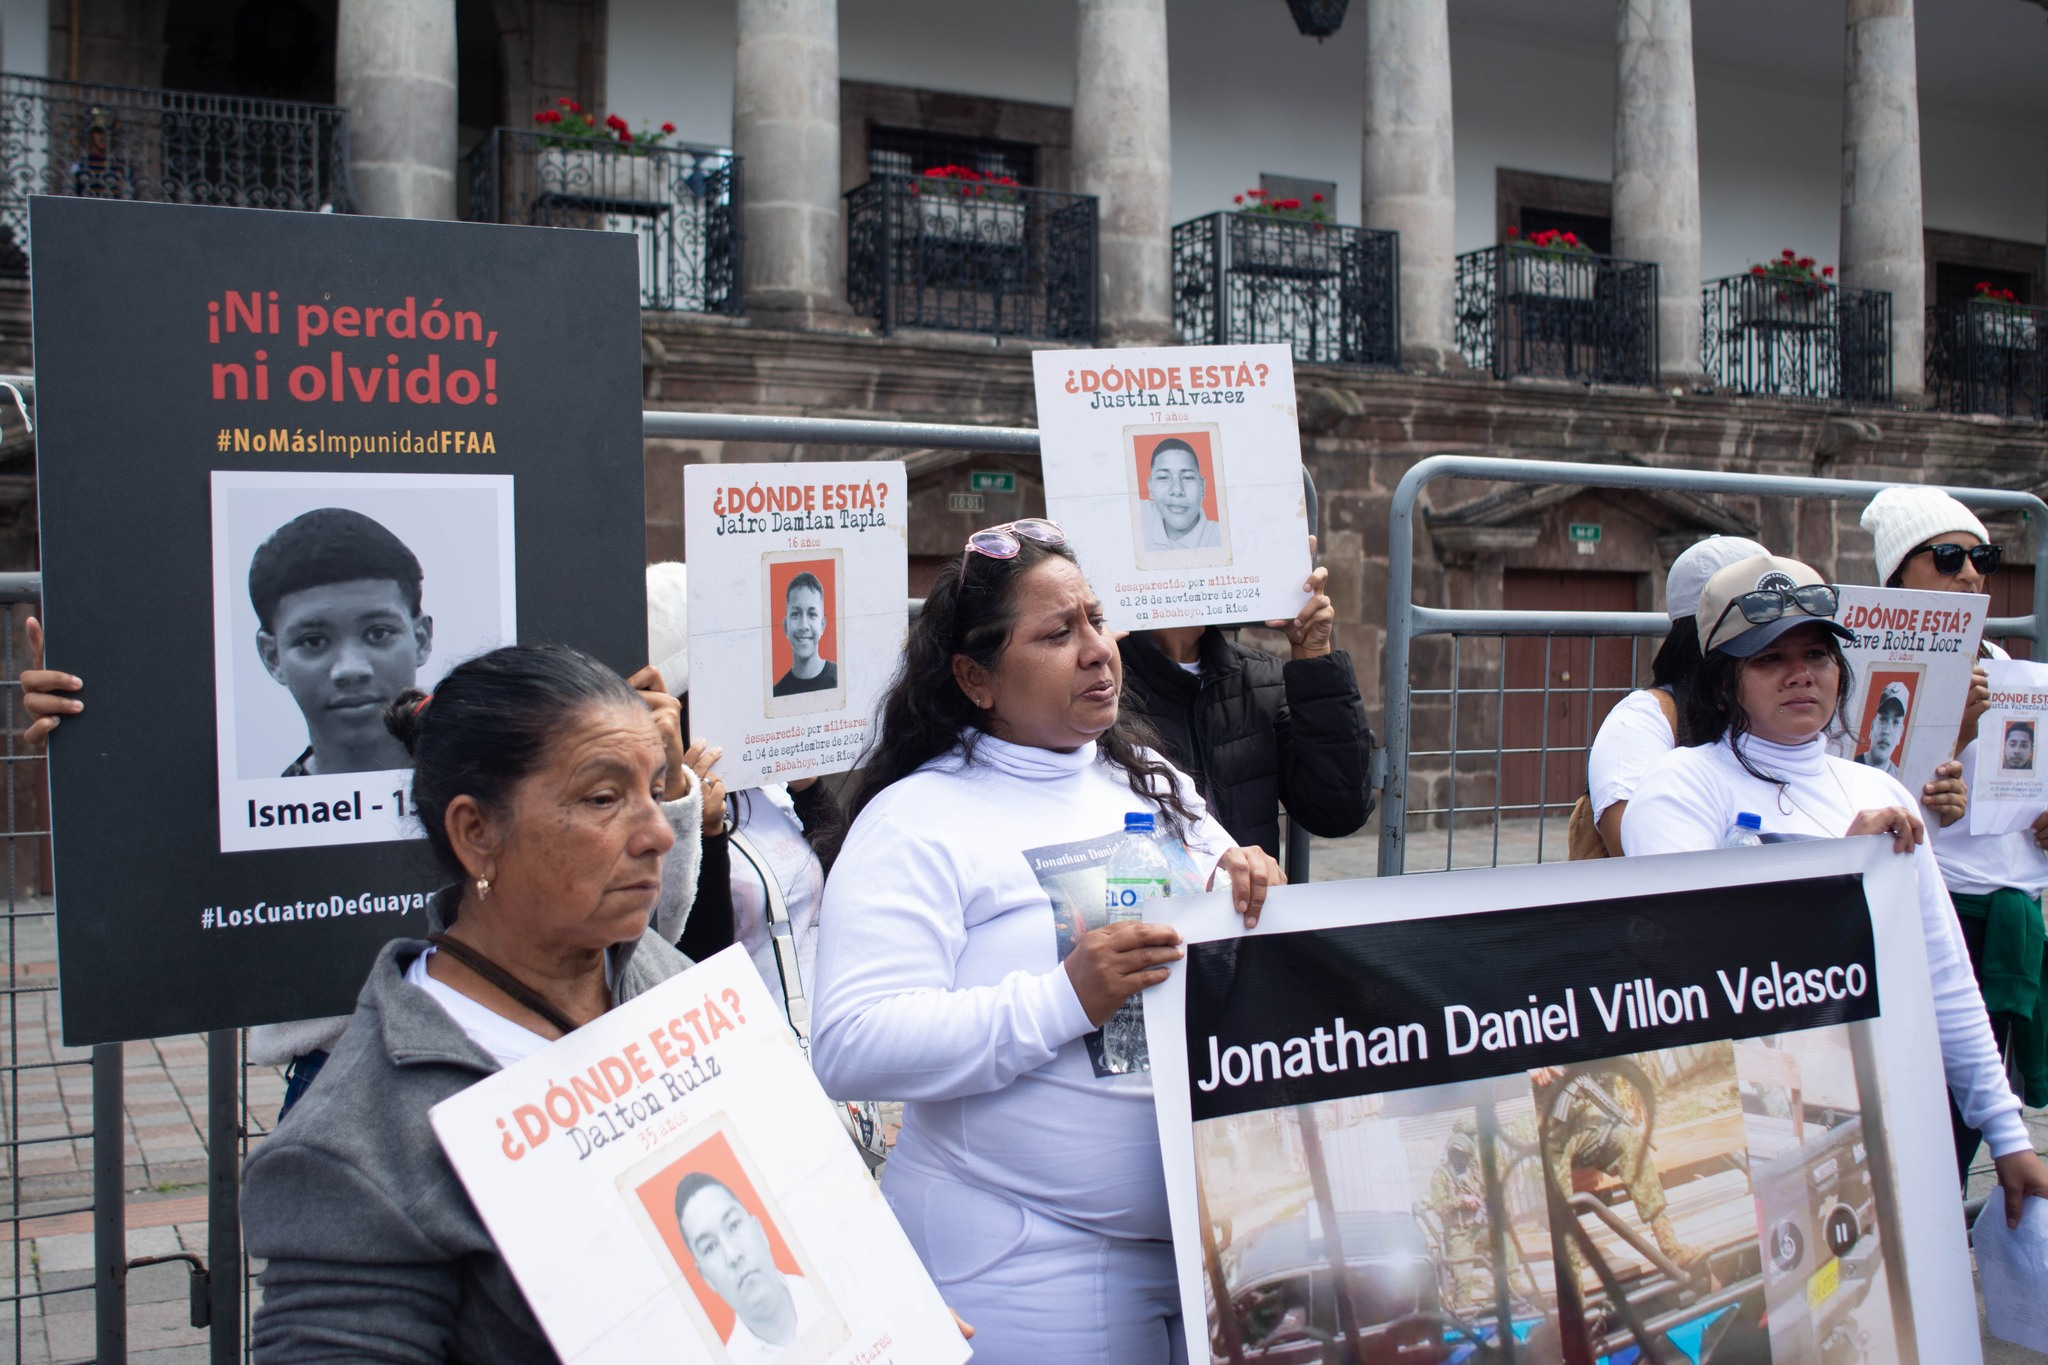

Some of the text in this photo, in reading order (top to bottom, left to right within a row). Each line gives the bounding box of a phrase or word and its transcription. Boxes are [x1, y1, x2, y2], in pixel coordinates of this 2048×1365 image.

[208, 290, 500, 347] ¡Ni perdón,
[211, 350, 499, 406] ni olvido!
[1065, 360, 1269, 394] ¿DÓNDE ESTÁ?
[1090, 387, 1245, 410] Justin Alvarez
[1149, 411, 1190, 423] 17 años
[216, 427, 497, 459] #NoMásImpunidadFFAA
[713, 479, 889, 515] ¿DÓNDE ESTÁ?
[716, 508, 886, 536] Jairo Damian Tapia
[787, 537, 821, 549] 16 años
[1114, 574, 1260, 594] desaparecido por militares
[1119, 588, 1261, 608] el 28 de noviembre de 2024
[1136, 611, 1149, 621] en
[1151, 605, 1204, 621] Babahoyo,
[1206, 605, 1223, 616] los
[1843, 602, 1971, 634] ¿DÓNDE ESTÁ?
[1882, 630, 1925, 652] Robin
[1928, 632, 1962, 653] Loor
[1888, 652, 1898, 661] 20
[1989, 690, 2048, 705] DÓNDE EST
[745, 717, 867, 745] desaparecido por militares
[742, 732, 865, 762] el 04 de septiembre de 2024
[761, 764, 773, 775] en
[774, 756, 819, 773] Babahoyo,
[820, 753, 835, 765] los
[247, 790, 363, 828] Ismael
[392, 789, 418, 817] 1
[1035, 852, 1088, 870] Jonathan
[201, 892, 437, 930] #LosCuatroDeGuaya
[1198, 962, 1867, 1092] Jonathan Daniel Villon Velasco
[496, 988, 747, 1161] ¿DÓNDE ESTÁ?
[565, 1054, 722, 1161] Dalton Ruiz
[637, 1111, 689, 1151] 35 años
